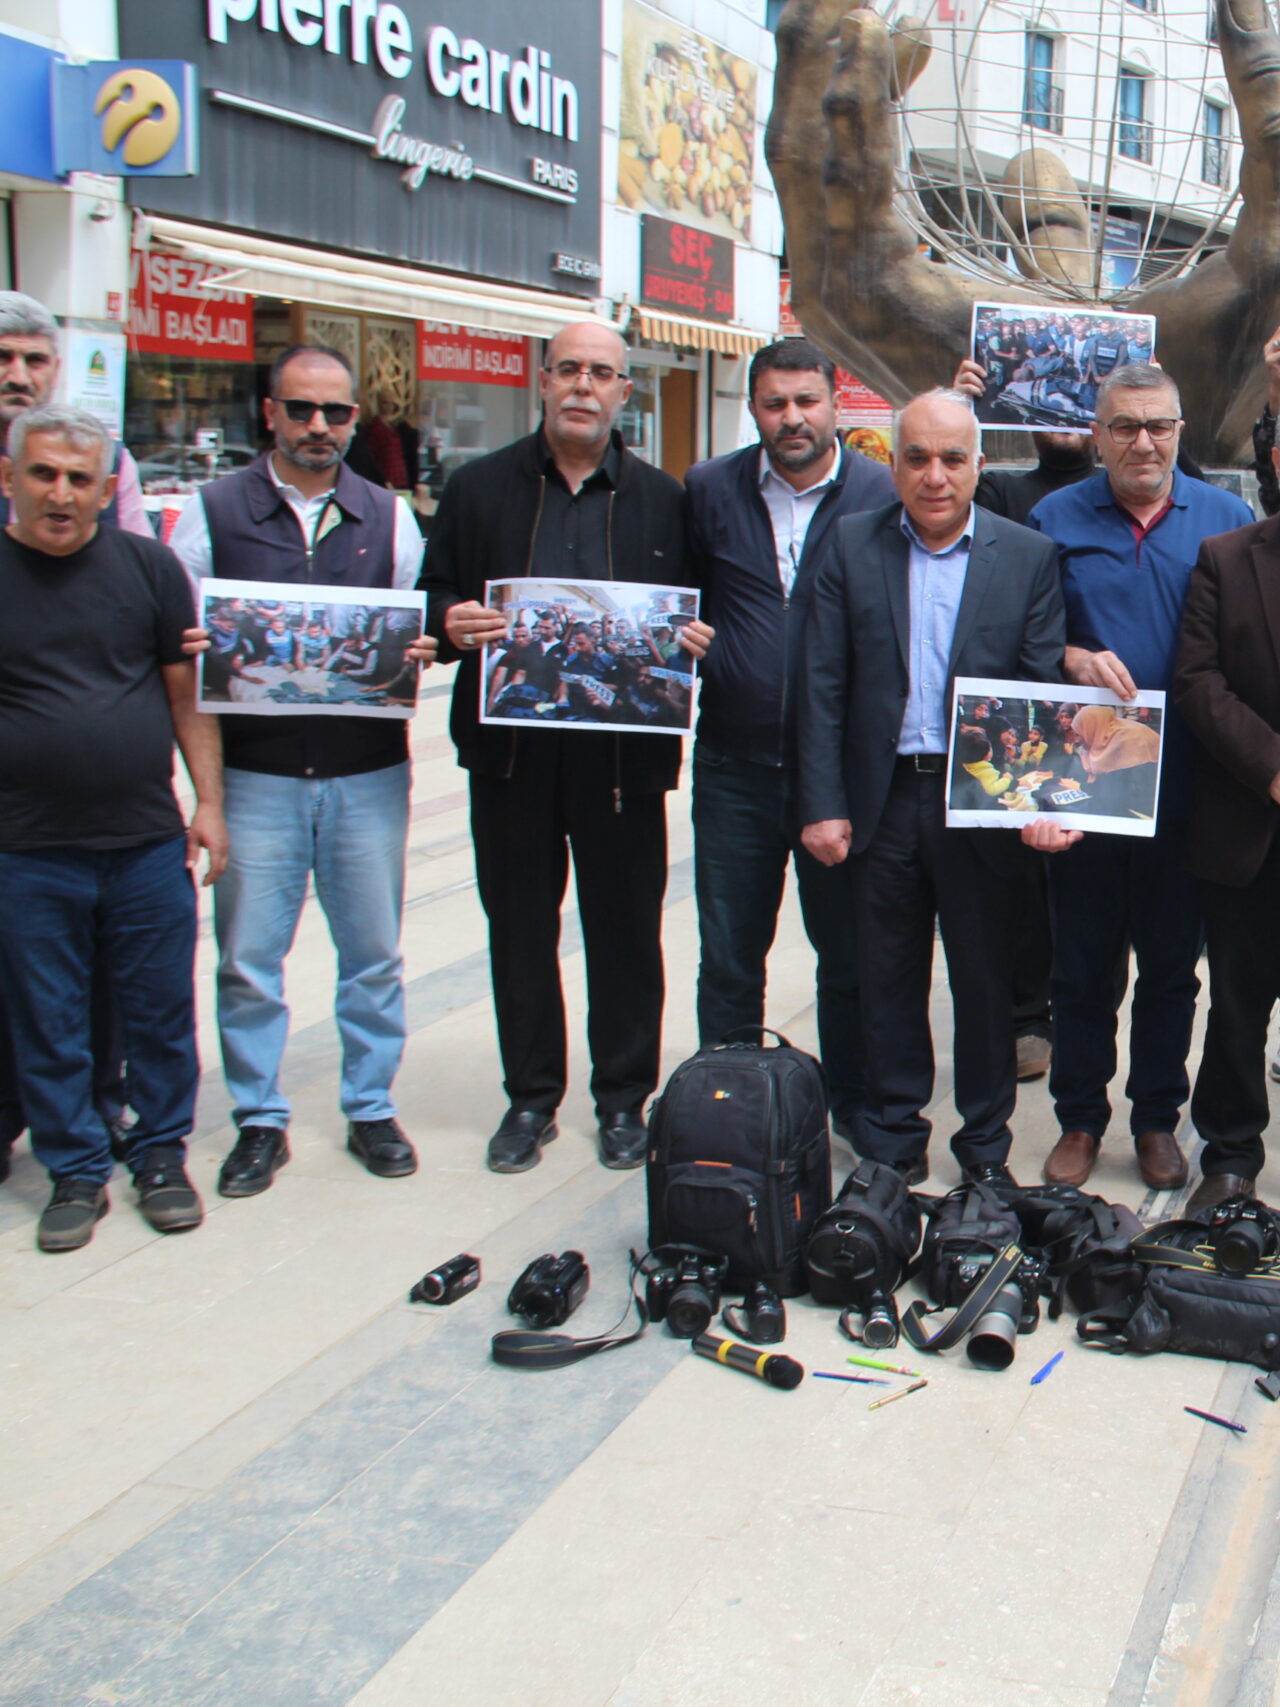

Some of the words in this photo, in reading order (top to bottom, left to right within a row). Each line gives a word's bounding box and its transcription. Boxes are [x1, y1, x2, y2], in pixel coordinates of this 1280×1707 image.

[427, 25, 579, 142] cardin
[371, 94, 475, 190] lingerie
[532, 156, 579, 194] PARIS
[670, 223, 714, 281] SEÇ
[164, 310, 248, 346] BAŞLADI
[422, 339, 472, 370] İNDİRİMİ
[474, 348, 524, 376] BAŞLADI
